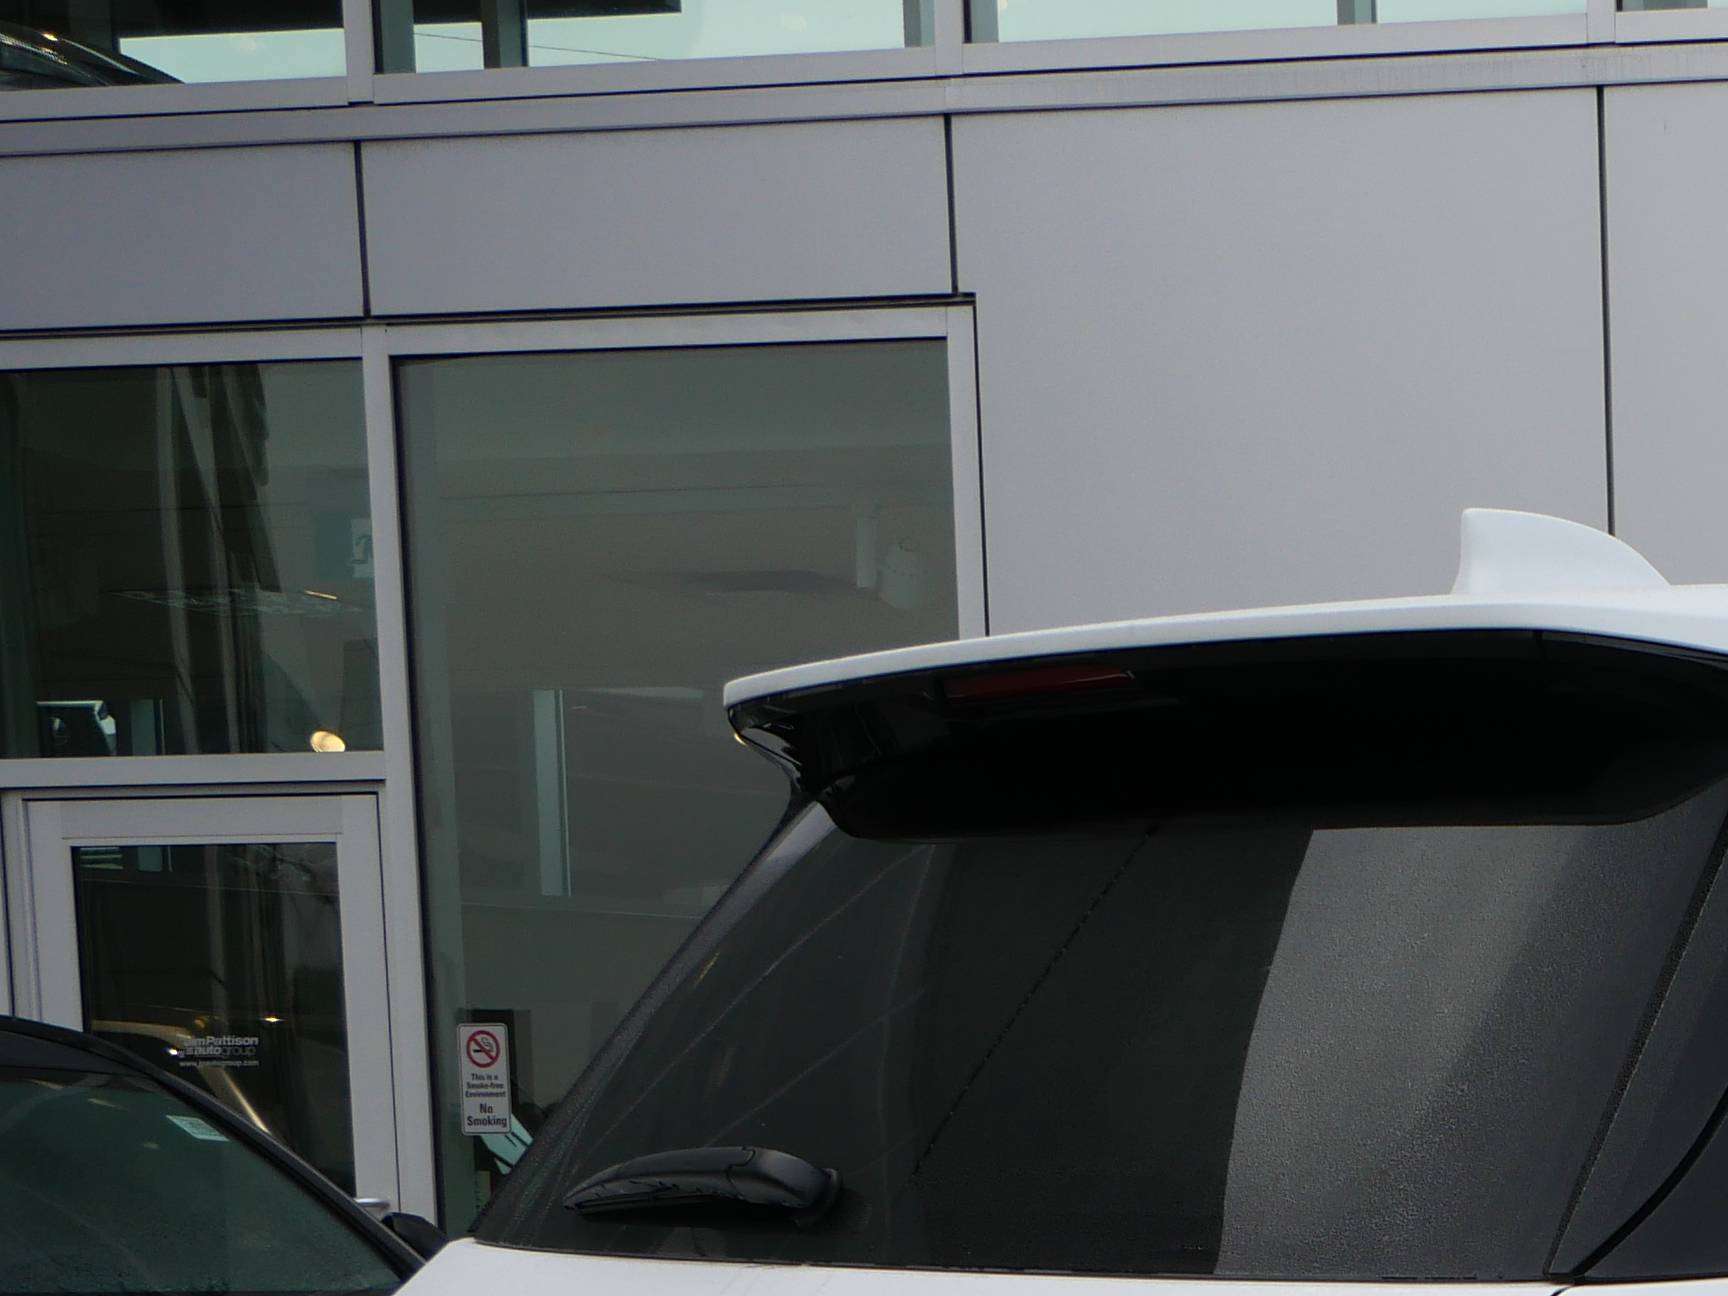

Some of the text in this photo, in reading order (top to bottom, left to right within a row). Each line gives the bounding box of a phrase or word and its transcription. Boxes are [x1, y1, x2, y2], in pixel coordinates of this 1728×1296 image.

[471, 1072, 486, 1081] This
[466, 1081, 505, 1090] Smoke-free
[464, 1091, 507, 1099] Environment
[479, 1103, 494, 1114] No
[466, 1115, 508, 1128] Smoking
